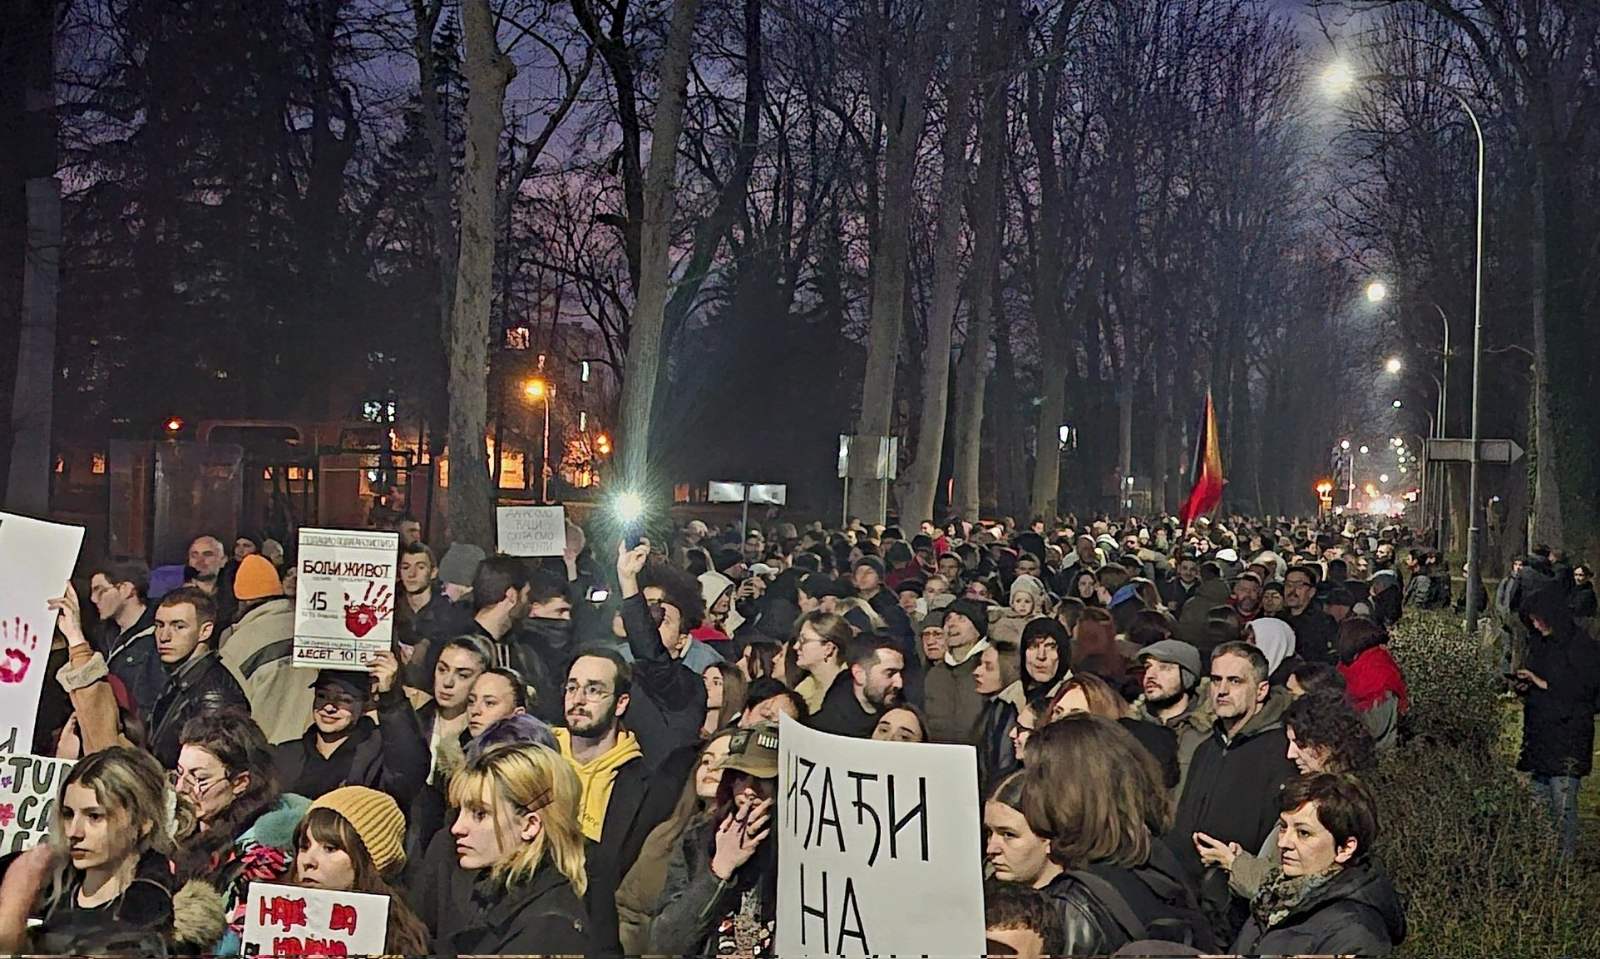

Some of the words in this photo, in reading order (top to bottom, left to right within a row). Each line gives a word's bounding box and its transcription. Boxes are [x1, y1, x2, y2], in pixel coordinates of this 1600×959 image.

[342, 562, 392, 578] ЖИВОТ
[309, 591, 327, 611] 15
[297, 648, 334, 660] ДЕСЕТ
[340, 650, 353, 661] 10
[786, 750, 929, 867] ИЗАЂИ
[800, 862, 869, 955] НА
